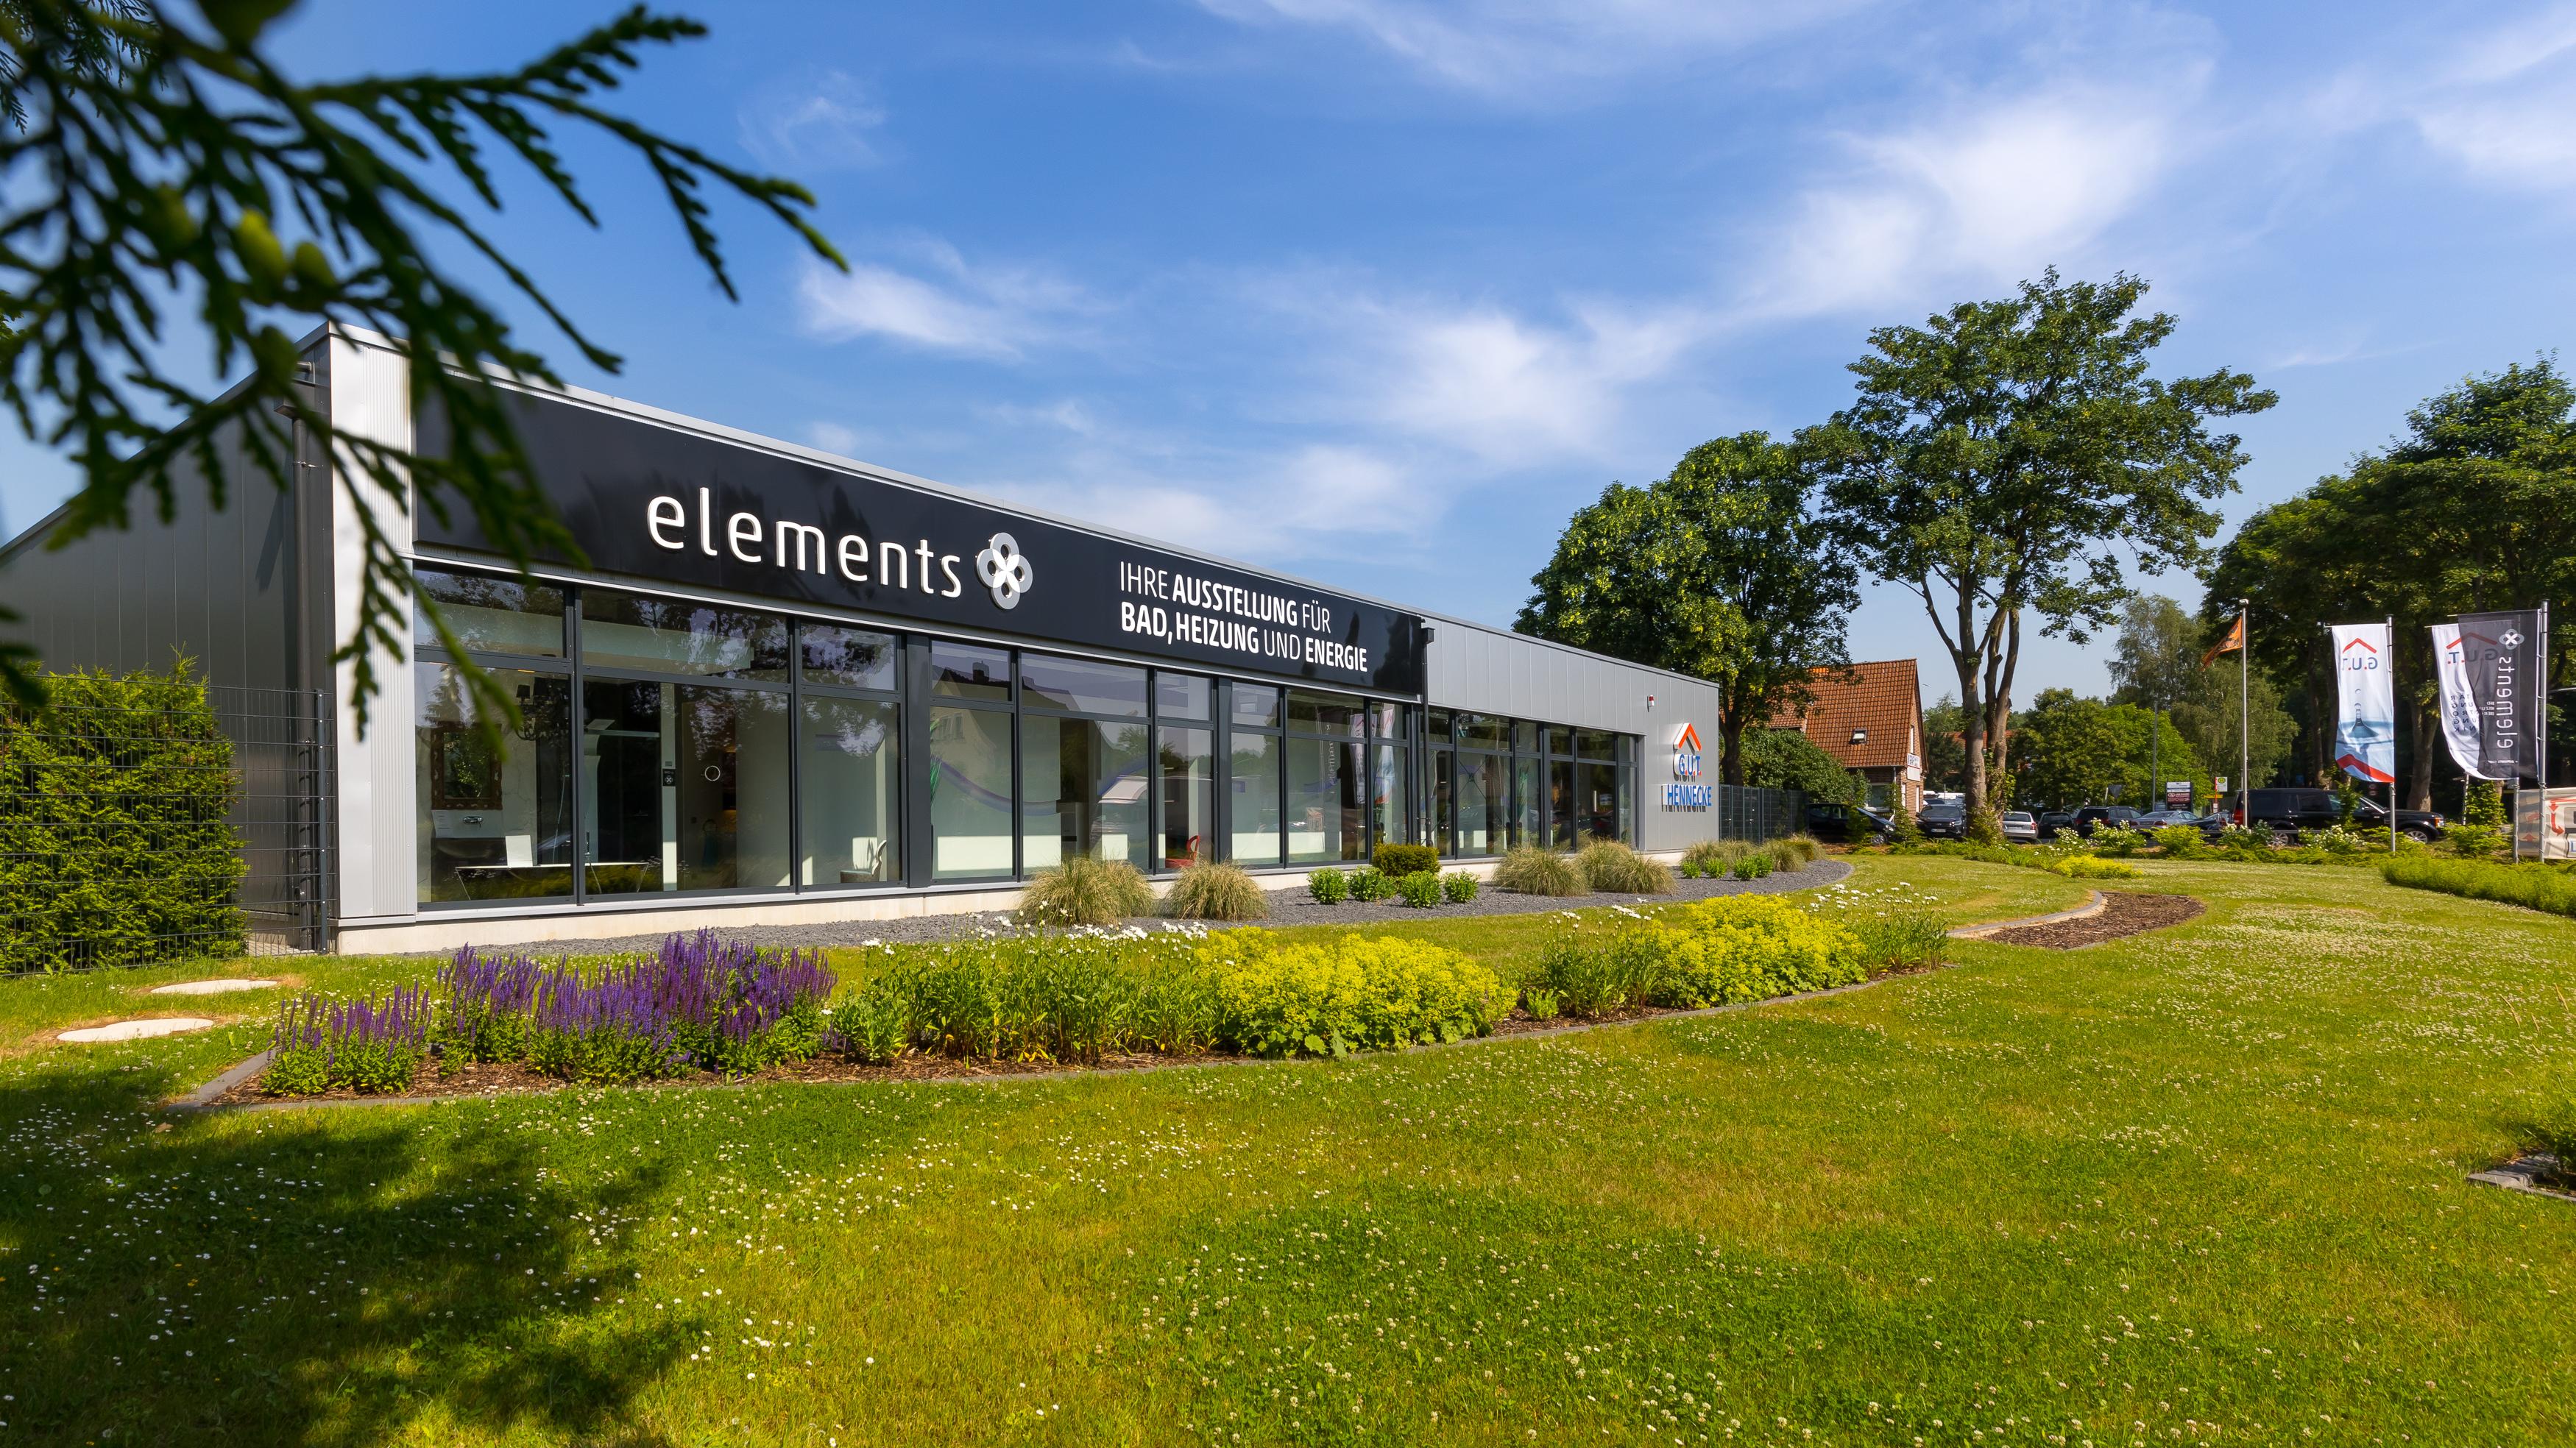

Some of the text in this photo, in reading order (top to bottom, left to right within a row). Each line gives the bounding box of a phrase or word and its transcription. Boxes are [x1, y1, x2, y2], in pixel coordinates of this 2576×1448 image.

[647, 487, 960, 598] elements
[1120, 561, 1331, 634] IHRE AUSSTELLUNG FÜR
[1121, 601, 1367, 672] BAD, HEIZUNG UND ENERGIE
[1667, 784, 1712, 806] HENNECKE
[1678, 753, 1702, 776] G.U.T.
